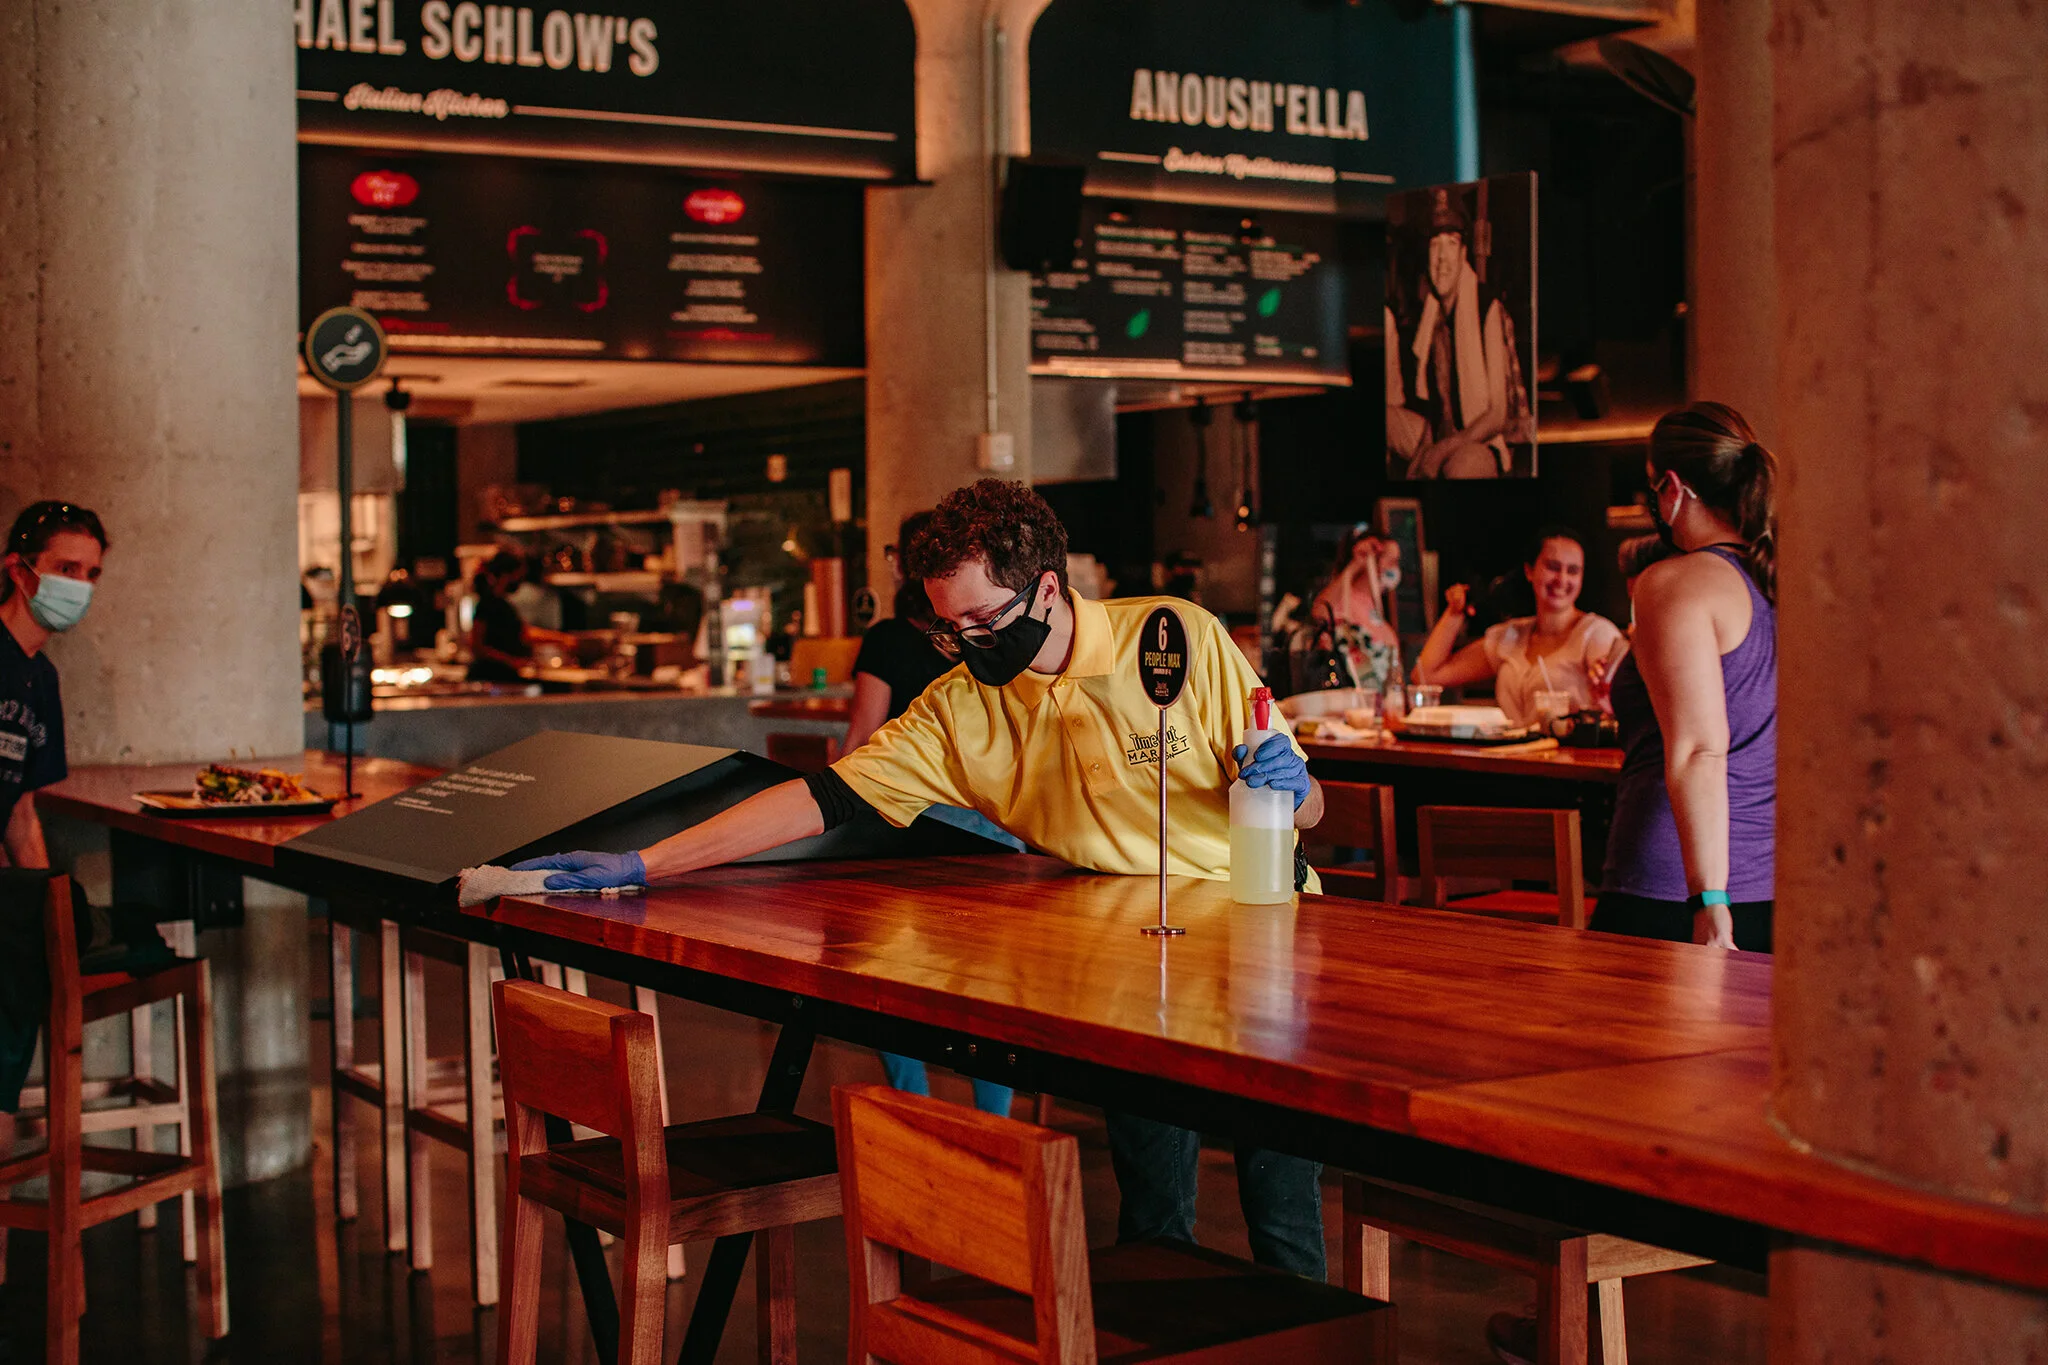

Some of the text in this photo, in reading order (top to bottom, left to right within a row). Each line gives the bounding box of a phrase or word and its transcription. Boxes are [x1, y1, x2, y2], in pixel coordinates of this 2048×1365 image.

[421, 0, 660, 77] SCHLOW'S
[1129, 68, 1369, 141] ANOUSH'ELLA
[1158, 616, 1168, 651] 6
[1144, 651, 1181, 668] PEOPLE MAX
[1127, 738, 1188, 762] MARET
